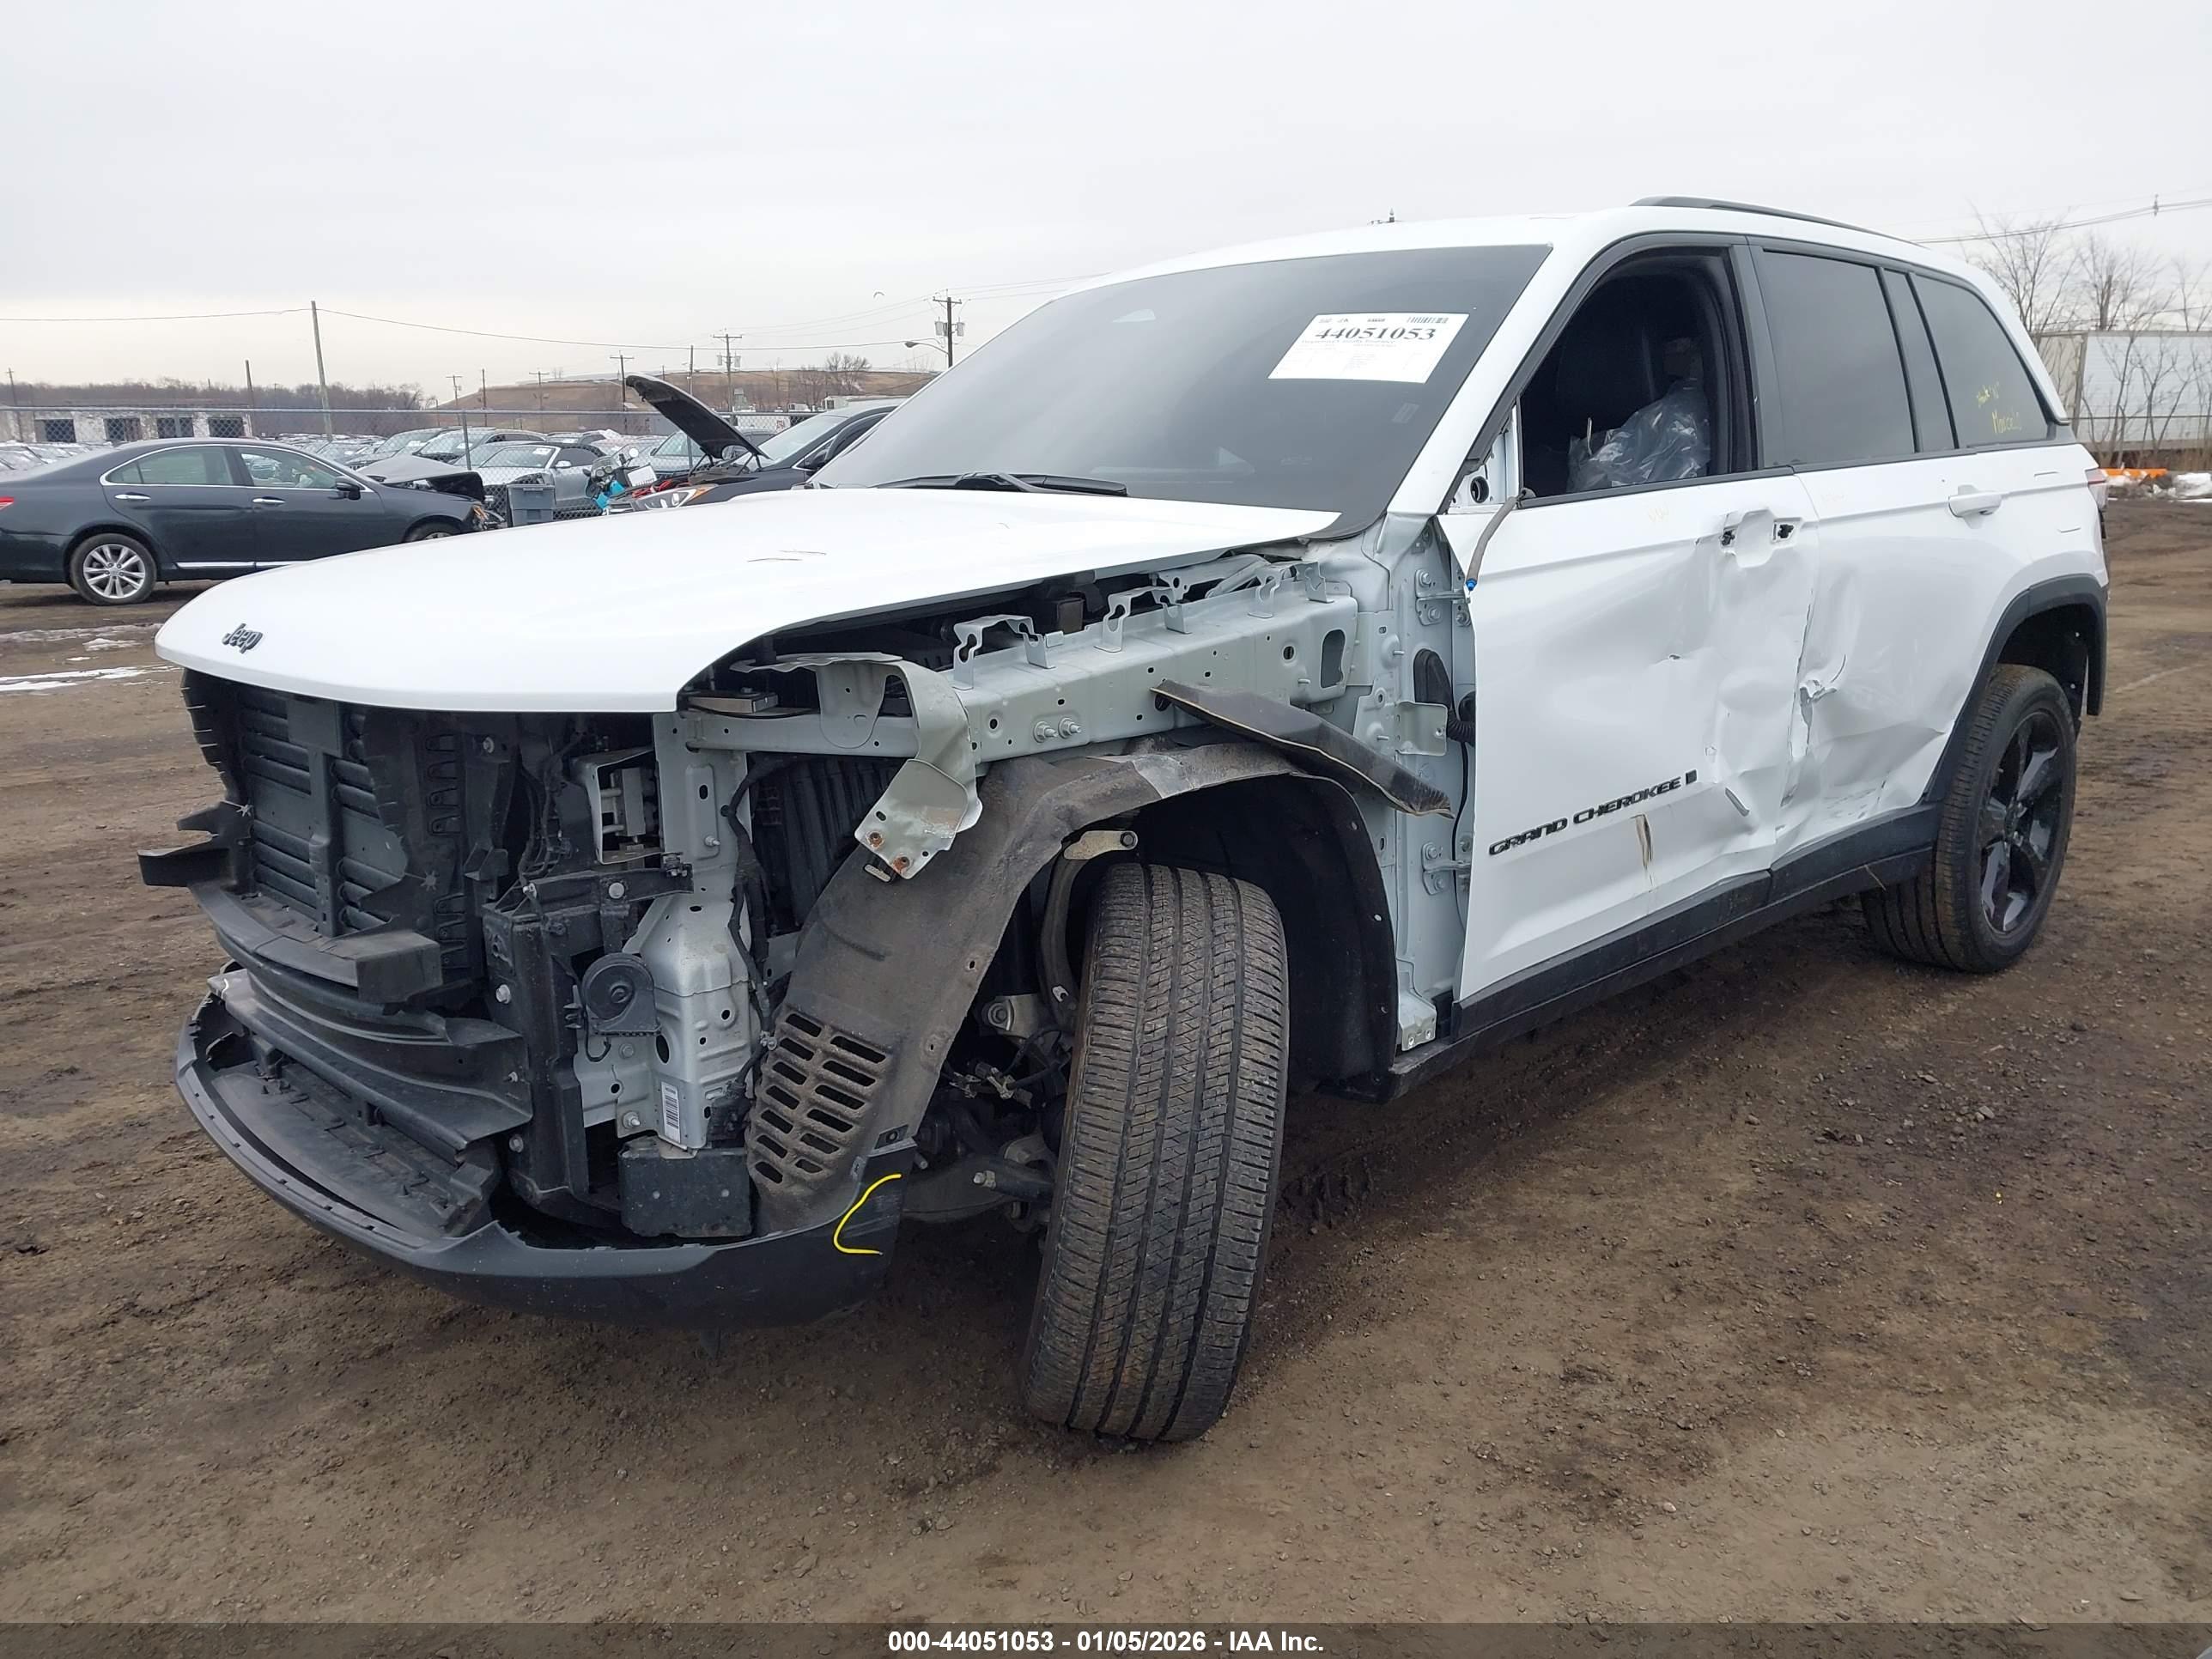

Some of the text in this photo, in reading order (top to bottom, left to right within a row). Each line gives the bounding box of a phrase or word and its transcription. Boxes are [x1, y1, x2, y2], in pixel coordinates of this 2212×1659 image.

[1315, 327, 1437, 340] 44051053
[222, 623, 264, 653] Jeep
[1489, 776, 1681, 856] GRAND CHEROKEE
